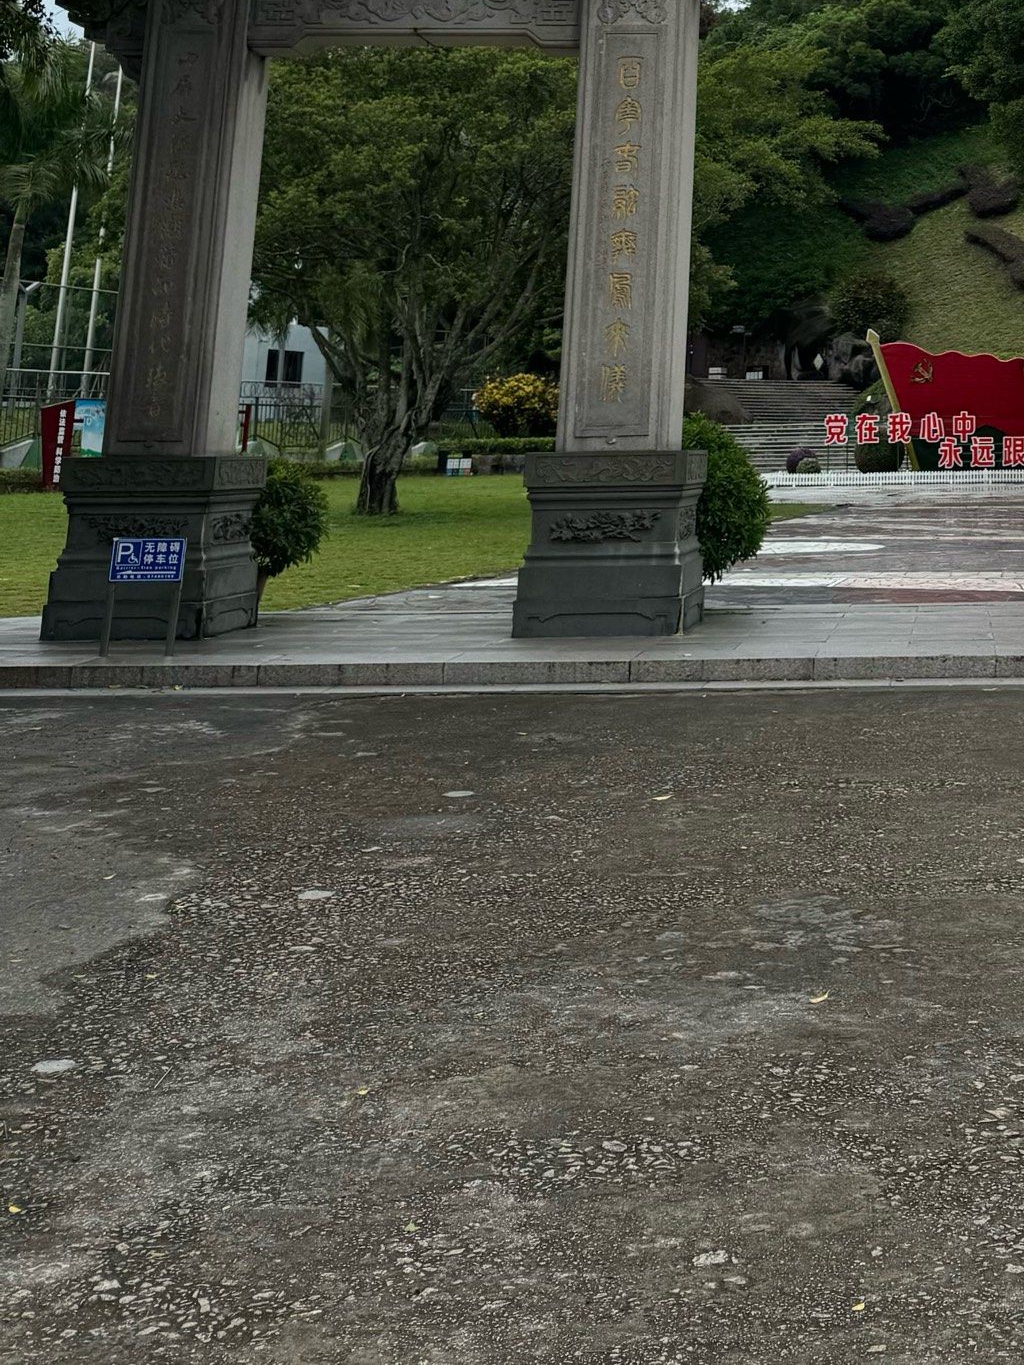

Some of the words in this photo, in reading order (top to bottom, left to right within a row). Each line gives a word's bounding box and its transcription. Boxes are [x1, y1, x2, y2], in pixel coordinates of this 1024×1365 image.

[824, 411, 977, 446] 党在我心中
[117, 542, 134, 563] P
[144, 542, 180, 553] 无障碍
[143, 554, 178, 564] 停车位
